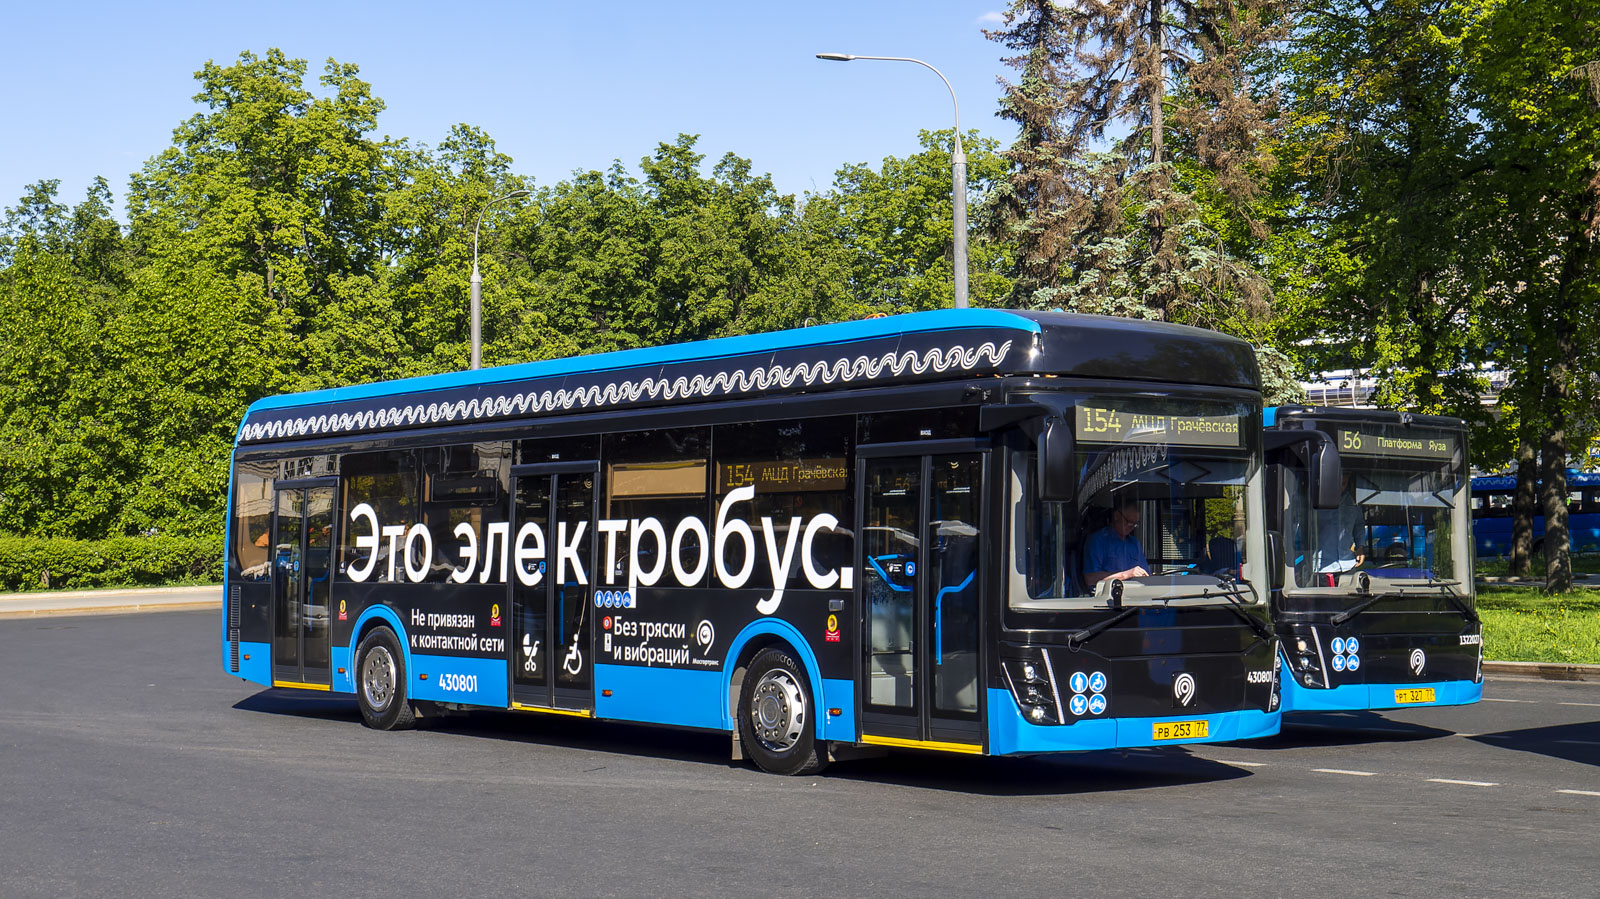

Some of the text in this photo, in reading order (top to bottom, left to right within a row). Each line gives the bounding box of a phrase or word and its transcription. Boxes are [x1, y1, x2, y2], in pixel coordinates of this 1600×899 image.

[1083, 407, 1239, 435] 154 МЦД Грачёвская
[1343, 431, 1447, 452] 56 Платформа Яуза
[726, 464, 755, 487] 154
[761, 466, 790, 484] МЦД
[346, 502, 433, 583] Это
[411, 608, 475, 631] Не привязан
[614, 615, 686, 642] Без тряски
[411, 633, 505, 653] к контактной сети
[614, 641, 690, 667] и вибраций
[438, 673, 478, 693] 430801
[1247, 670, 1273, 683] 430801
[1410, 690, 1423, 701] 327
[1158, 727, 1170, 738] РВ
[1173, 723, 1191, 737] 253
[1196, 722, 1206, 732] 77
